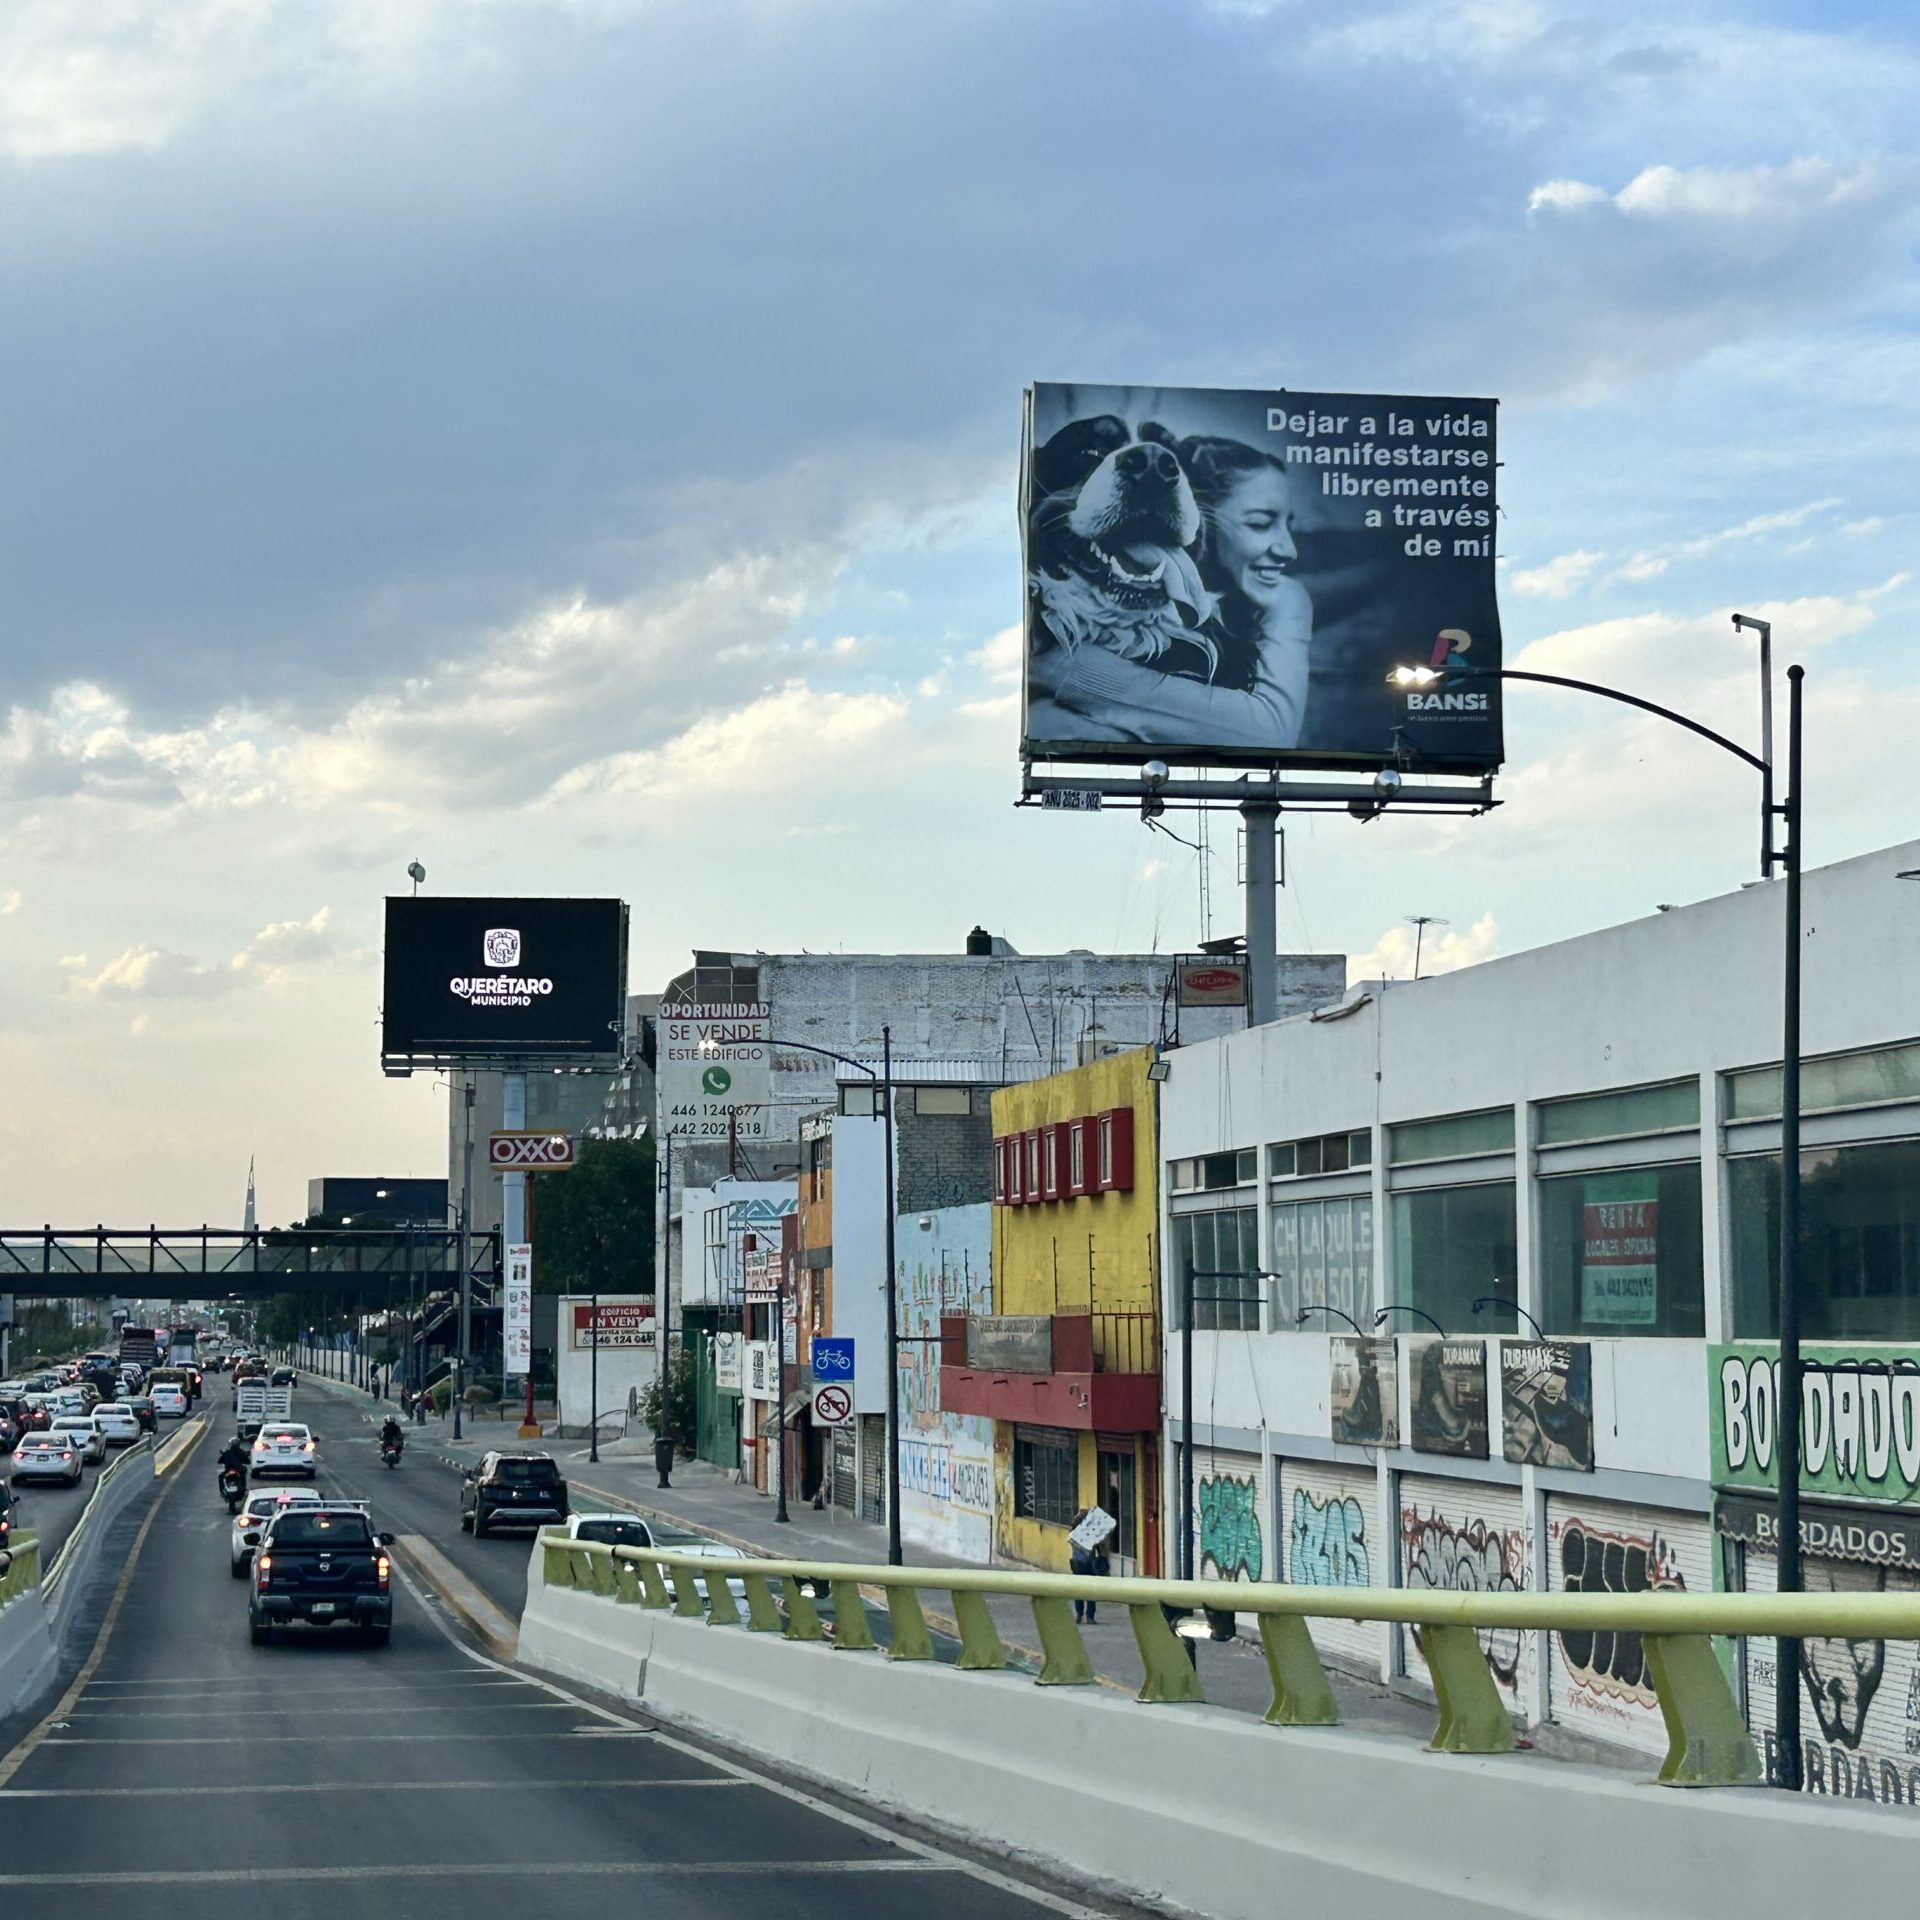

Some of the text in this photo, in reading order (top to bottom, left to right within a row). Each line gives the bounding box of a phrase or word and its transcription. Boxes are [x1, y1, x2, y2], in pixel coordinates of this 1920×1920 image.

[1267, 408, 1488, 437] Dejar a la vida
[1286, 443, 1488, 467] manifestarse
[1323, 472, 1489, 496] libremente
[1365, 504, 1490, 527] a través
[1404, 534, 1490, 557] de mí
[1407, 693, 1487, 710] BANSi
[450, 974, 553, 998] QUERÉTARO
[471, 996, 531, 1006] MUNICIPIO
[661, 1003, 769, 1018] OPORTUNIDAD
[669, 1025, 762, 1040] SE VENDE
[669, 1048, 763, 1060] ESTE EDIFICIO
[671, 1104, 696, 1116] 446
[671, 1123, 761, 1135] 442 202518
[492, 1137, 570, 1163] OXXO
[609, 1316, 644, 1328] VENT
[1443, 1347, 1481, 1365] DURAMAX
[1503, 1347, 1551, 1371] DURAMAX
[1720, 1355, 1920, 1487] BODADO
